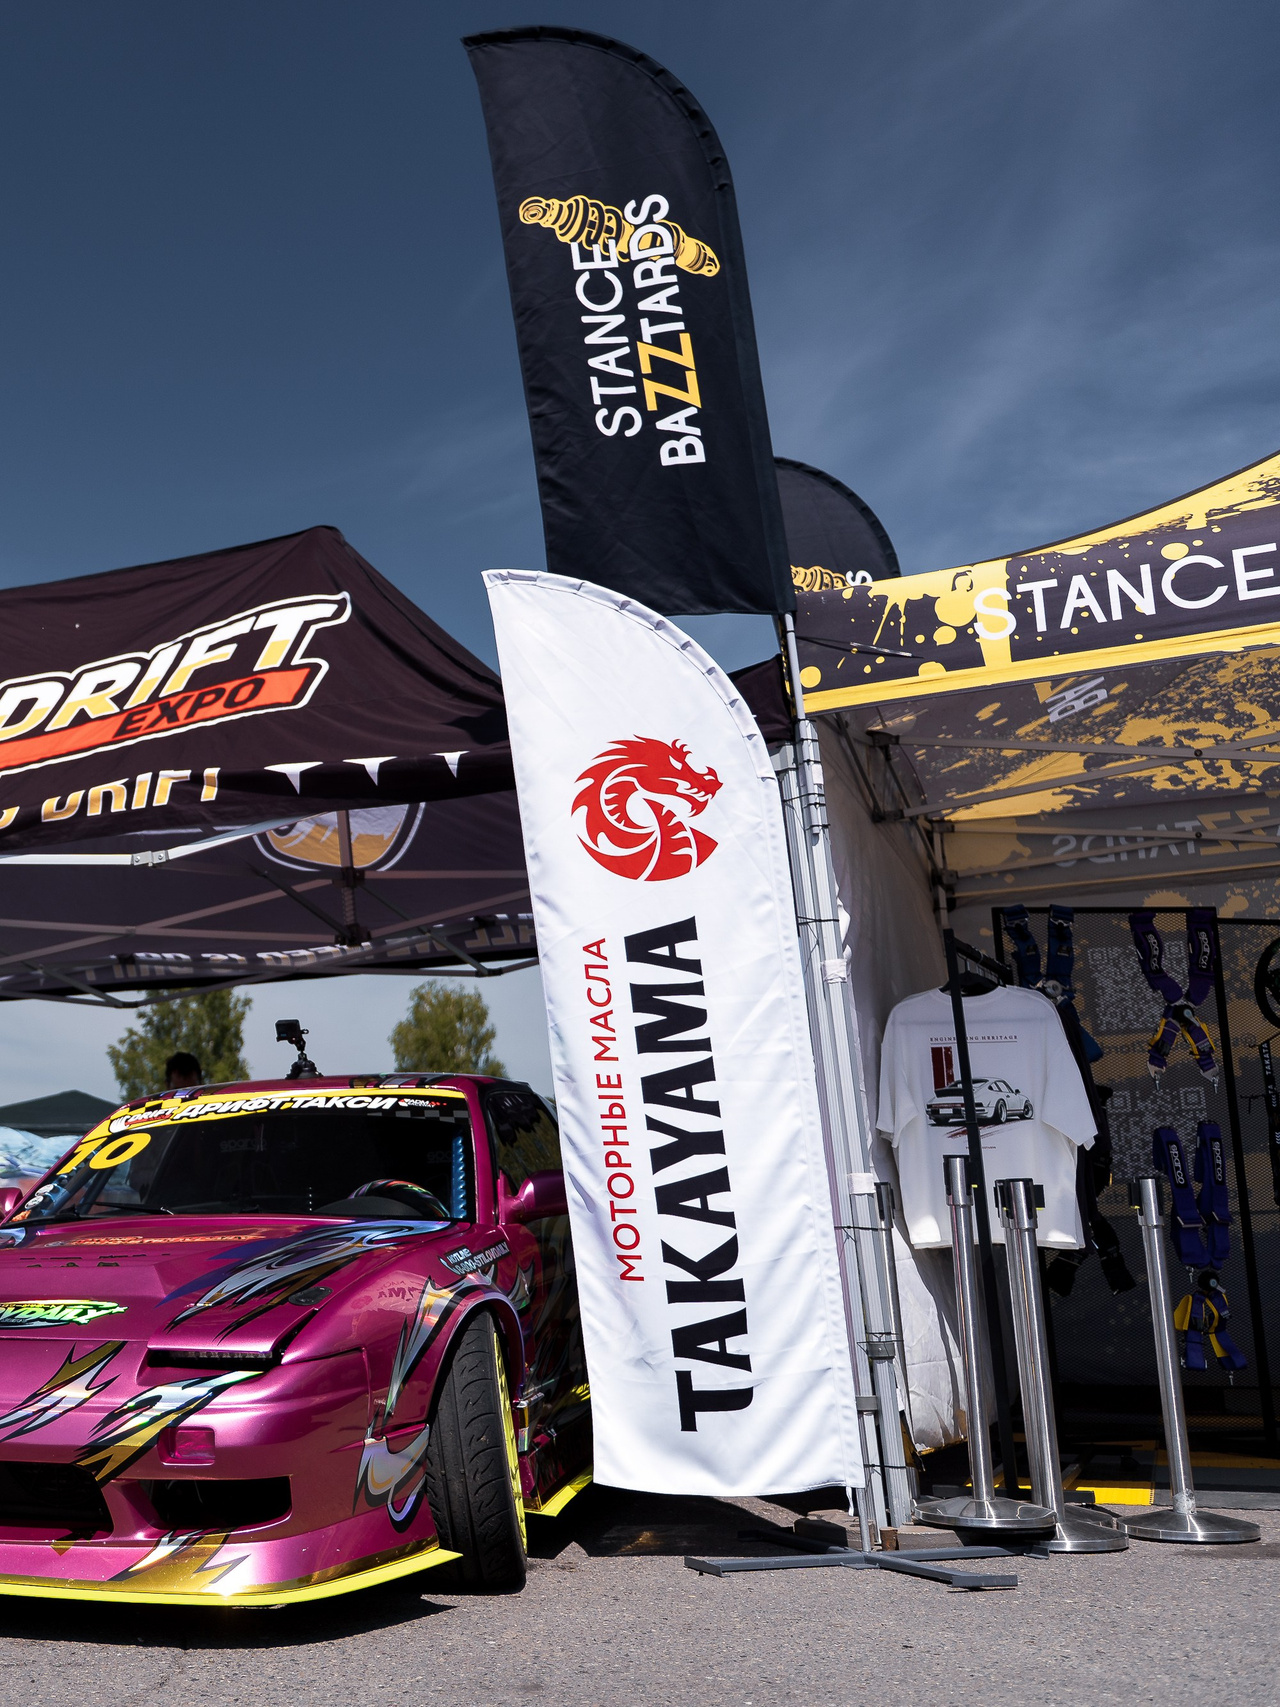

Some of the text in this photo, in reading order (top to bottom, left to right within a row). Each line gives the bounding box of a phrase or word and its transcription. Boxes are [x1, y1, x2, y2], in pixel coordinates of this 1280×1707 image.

[570, 239, 643, 437] STANCE
[624, 194, 706, 466] BAZZTARDS
[973, 543, 1280, 640] STANCE
[112, 676, 269, 739] EXPO
[930, 1035, 980, 1043] ENGINEING
[128, 1106, 180, 1123] DRIFT
[582, 938, 645, 1282] МОТОРНЫЕ МАСЛА
[56, 1132, 152, 1175] 10
[624, 915, 754, 1432] TAKAYAMA
[1169, 1144, 1185, 1185] sparco
[1212, 1141, 1223, 1181] sparco
